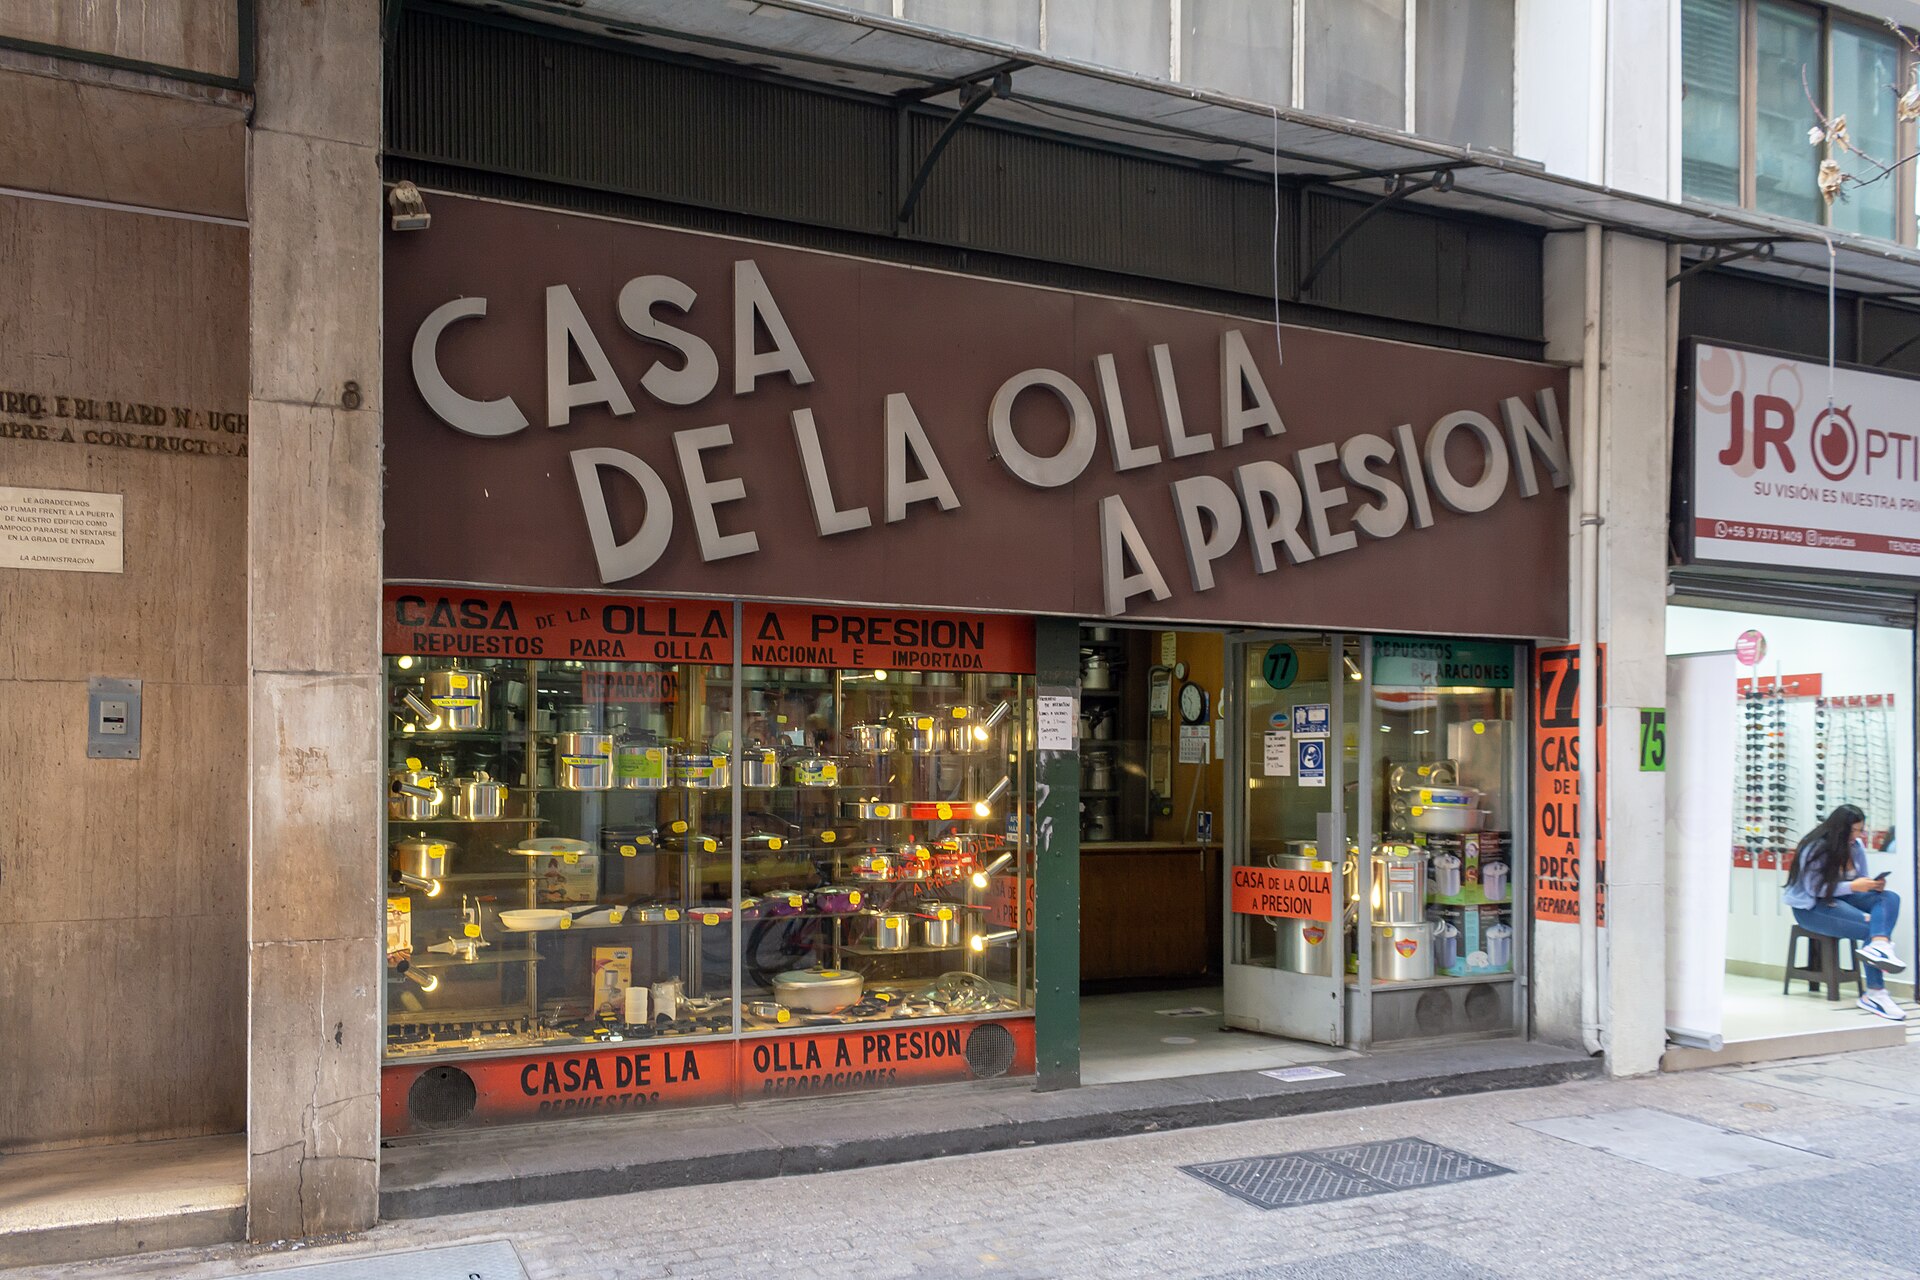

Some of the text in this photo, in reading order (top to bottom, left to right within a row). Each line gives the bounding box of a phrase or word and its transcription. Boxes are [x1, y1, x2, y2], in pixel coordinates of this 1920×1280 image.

[411, 259, 815, 438] CASA
[987, 329, 1287, 488] OLLA
[1718, 390, 1796, 473] JR
[34, 498, 90, 507] AGRADECEMOS
[569, 392, 961, 585] DE LA
[1098, 387, 1573, 617] A PRESION
[1754, 481, 1771, 496] SU
[1775, 484, 1819, 501] VISIÓN
[1822, 489, 1837, 503] ES
[1841, 491, 1897, 510] NUESTRA
[17, 515, 52, 524] NUESTRO
[54, 518, 84, 526] EDIFICIO
[34, 526, 68, 535] PARARSE
[80, 529, 117, 537] SENTARSE
[1747, 527, 1755, 539] 9
[1756, 528, 1779, 541] 7373
[31, 535, 58, 543] GRADA
[71, 538, 106, 546] ENTRADA
[396, 595, 728, 639] CASA DE LA OLLA
[758, 612, 985, 650] A PRESION
[413, 633, 713, 660] REPUESTOS PARA OLLA
[752, 644, 983, 669] NACIONAL E IMPORTADA
[1374, 640, 1453, 660] REPUESTOS
[1269, 652, 1291, 681] 77
[1641, 710, 1665, 767] 75
[1541, 735, 1600, 772] CAS
[1554, 779, 1570, 794] DE
[1566, 841, 1575, 855] A
[1235, 871, 1330, 895] CASA DE LA OLLA
[1539, 856, 1605, 894] PRESN
[1252, 895, 1312, 915] A PRESION
[753, 1029, 962, 1073] OLLA A PRESION
[520, 1050, 701, 1096] CASA DE LA
